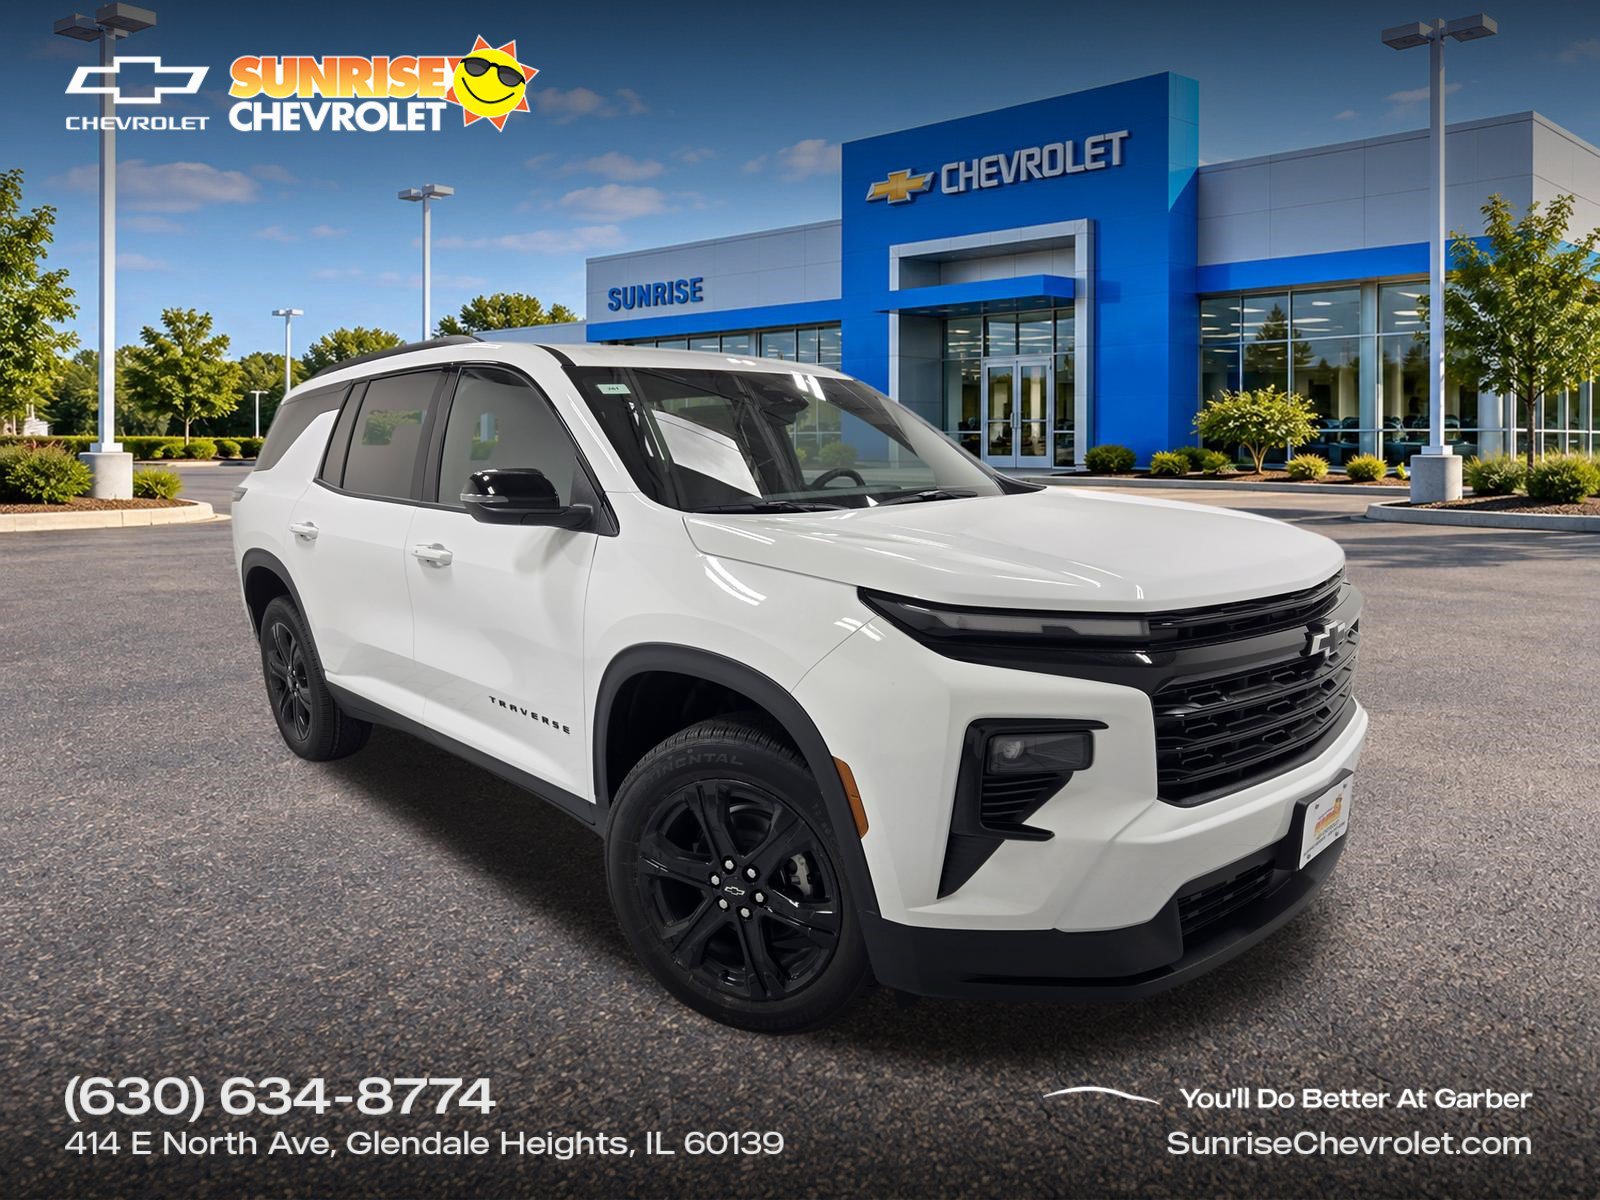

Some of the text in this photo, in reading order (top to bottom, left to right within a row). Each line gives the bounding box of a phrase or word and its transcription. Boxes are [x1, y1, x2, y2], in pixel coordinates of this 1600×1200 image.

[941, 130, 1129, 194] CHEVROLET
[607, 277, 704, 311] SUNRISE
[488, 695, 570, 735] TRAVERSE
